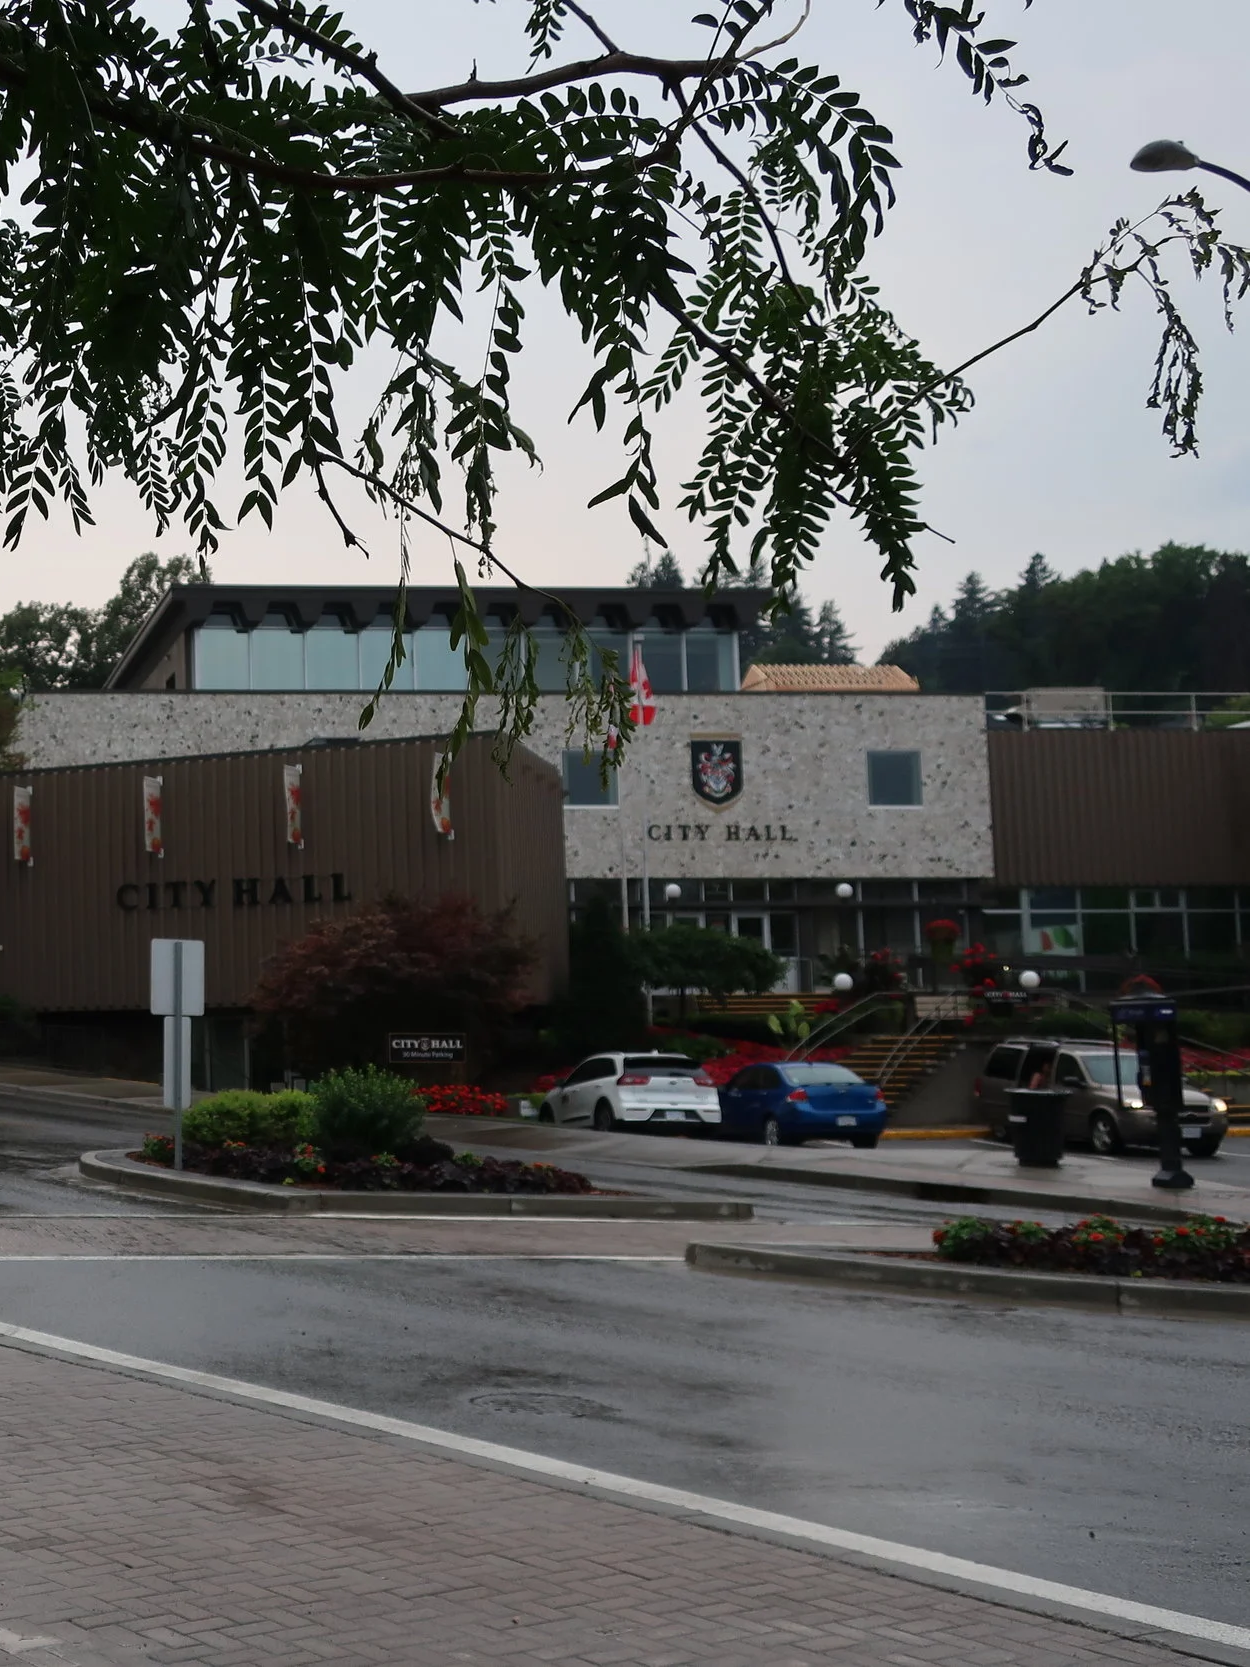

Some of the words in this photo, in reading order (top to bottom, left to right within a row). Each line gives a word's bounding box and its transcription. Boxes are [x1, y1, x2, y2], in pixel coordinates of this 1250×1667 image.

[648, 824, 711, 841] CITY
[726, 824, 796, 842] HALL
[116, 880, 215, 910] CITY
[233, 873, 351, 906] HALL
[392, 1039, 420, 1048] CITY
[431, 1039, 463, 1048] HALL
[432, 1051, 454, 1060] Parking
